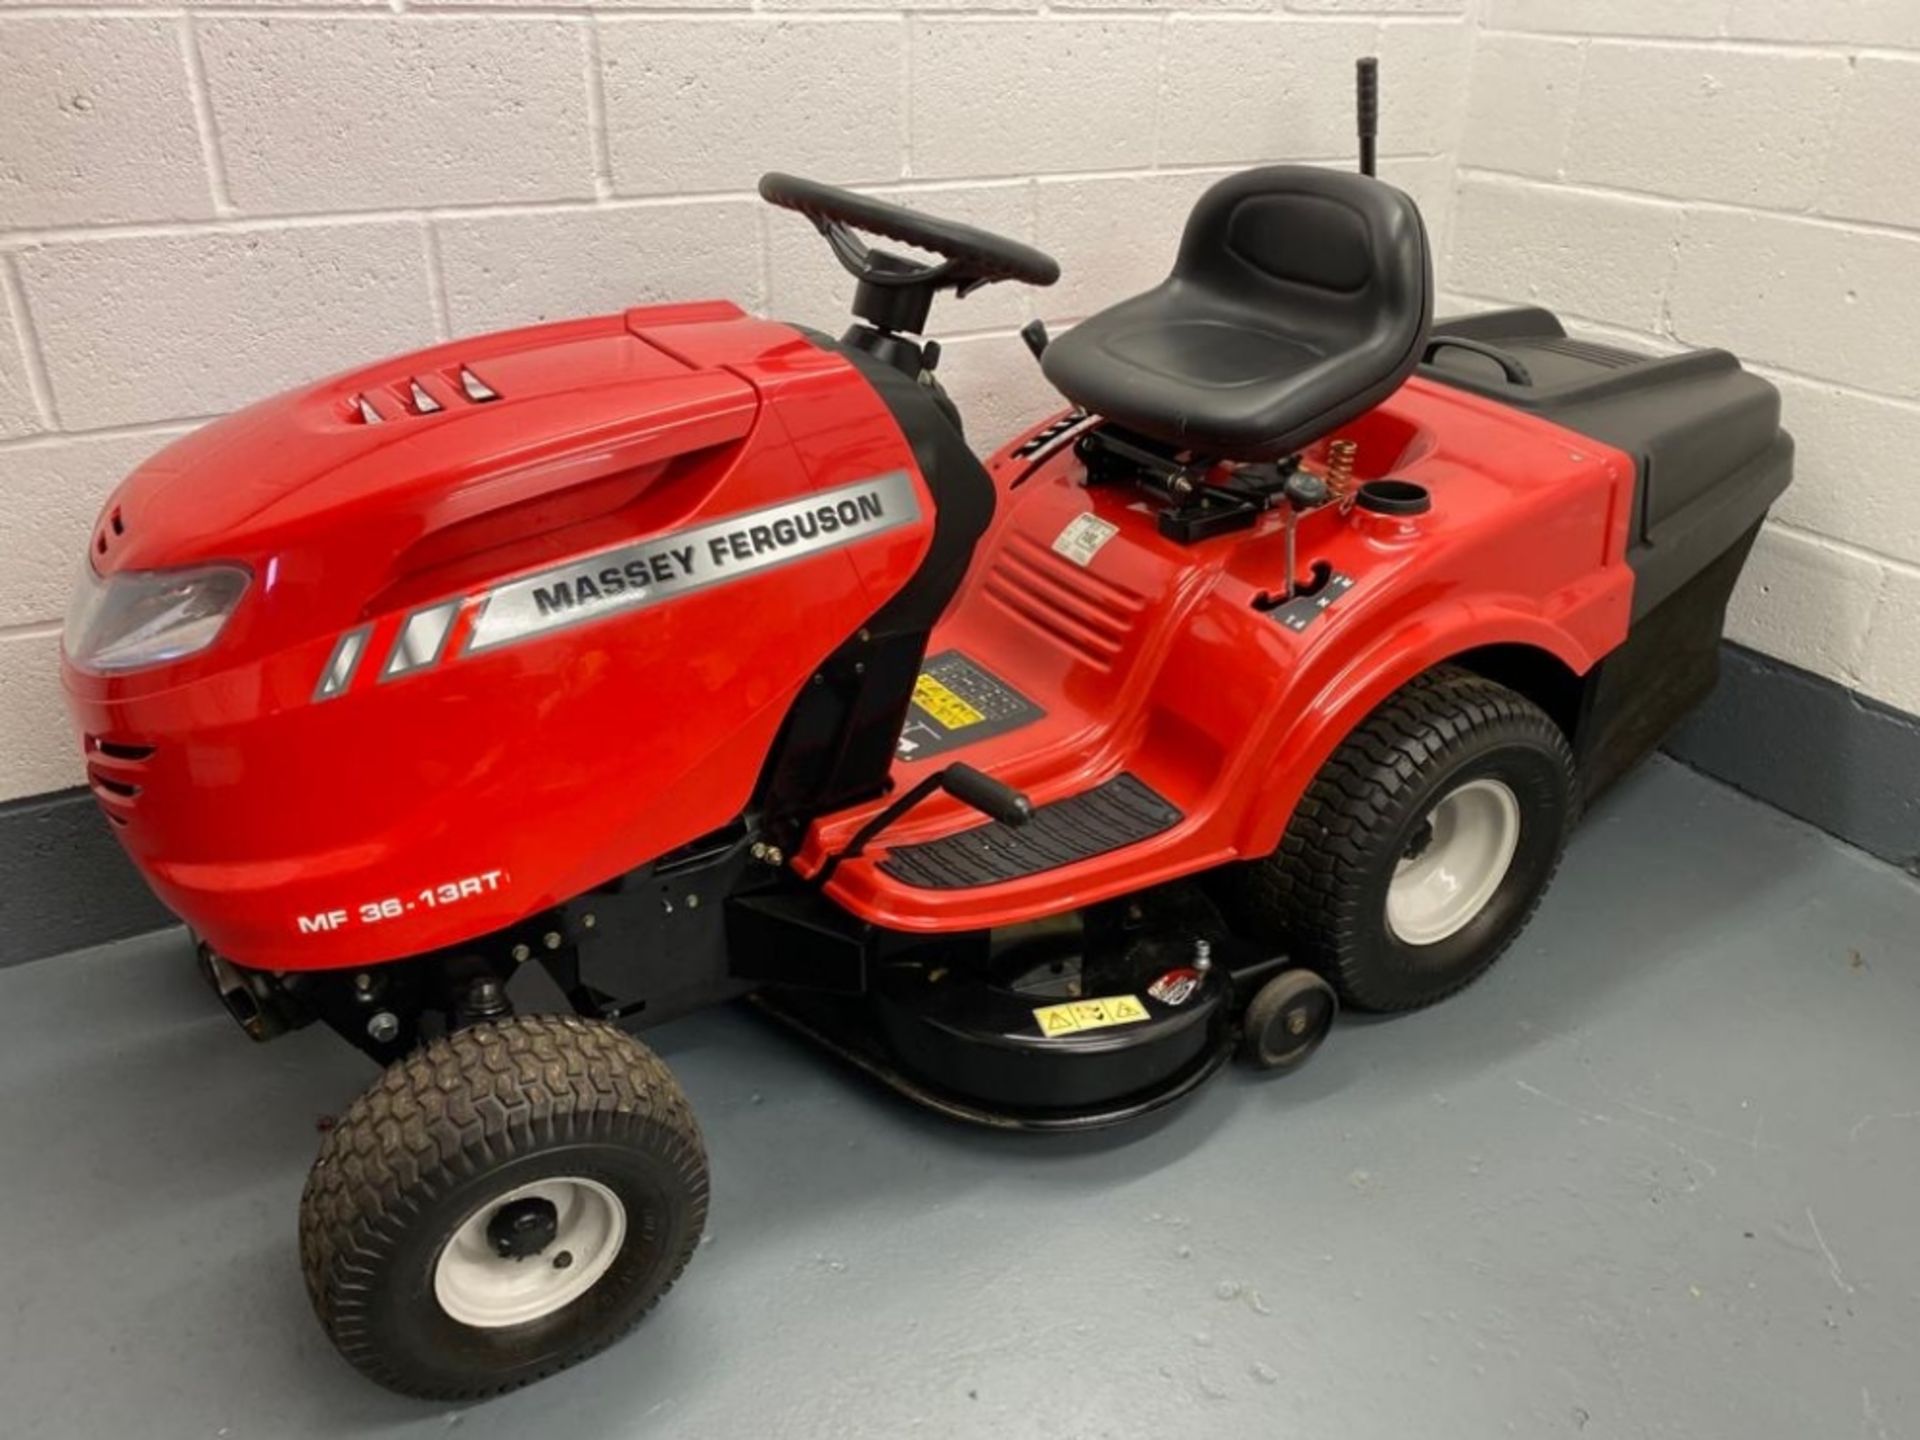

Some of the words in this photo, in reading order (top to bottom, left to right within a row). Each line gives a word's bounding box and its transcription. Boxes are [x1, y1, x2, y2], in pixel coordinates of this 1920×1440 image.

[532, 545, 696, 616] MASSEY
[708, 492, 884, 566] FERGUSON
[297, 910, 348, 933] MF
